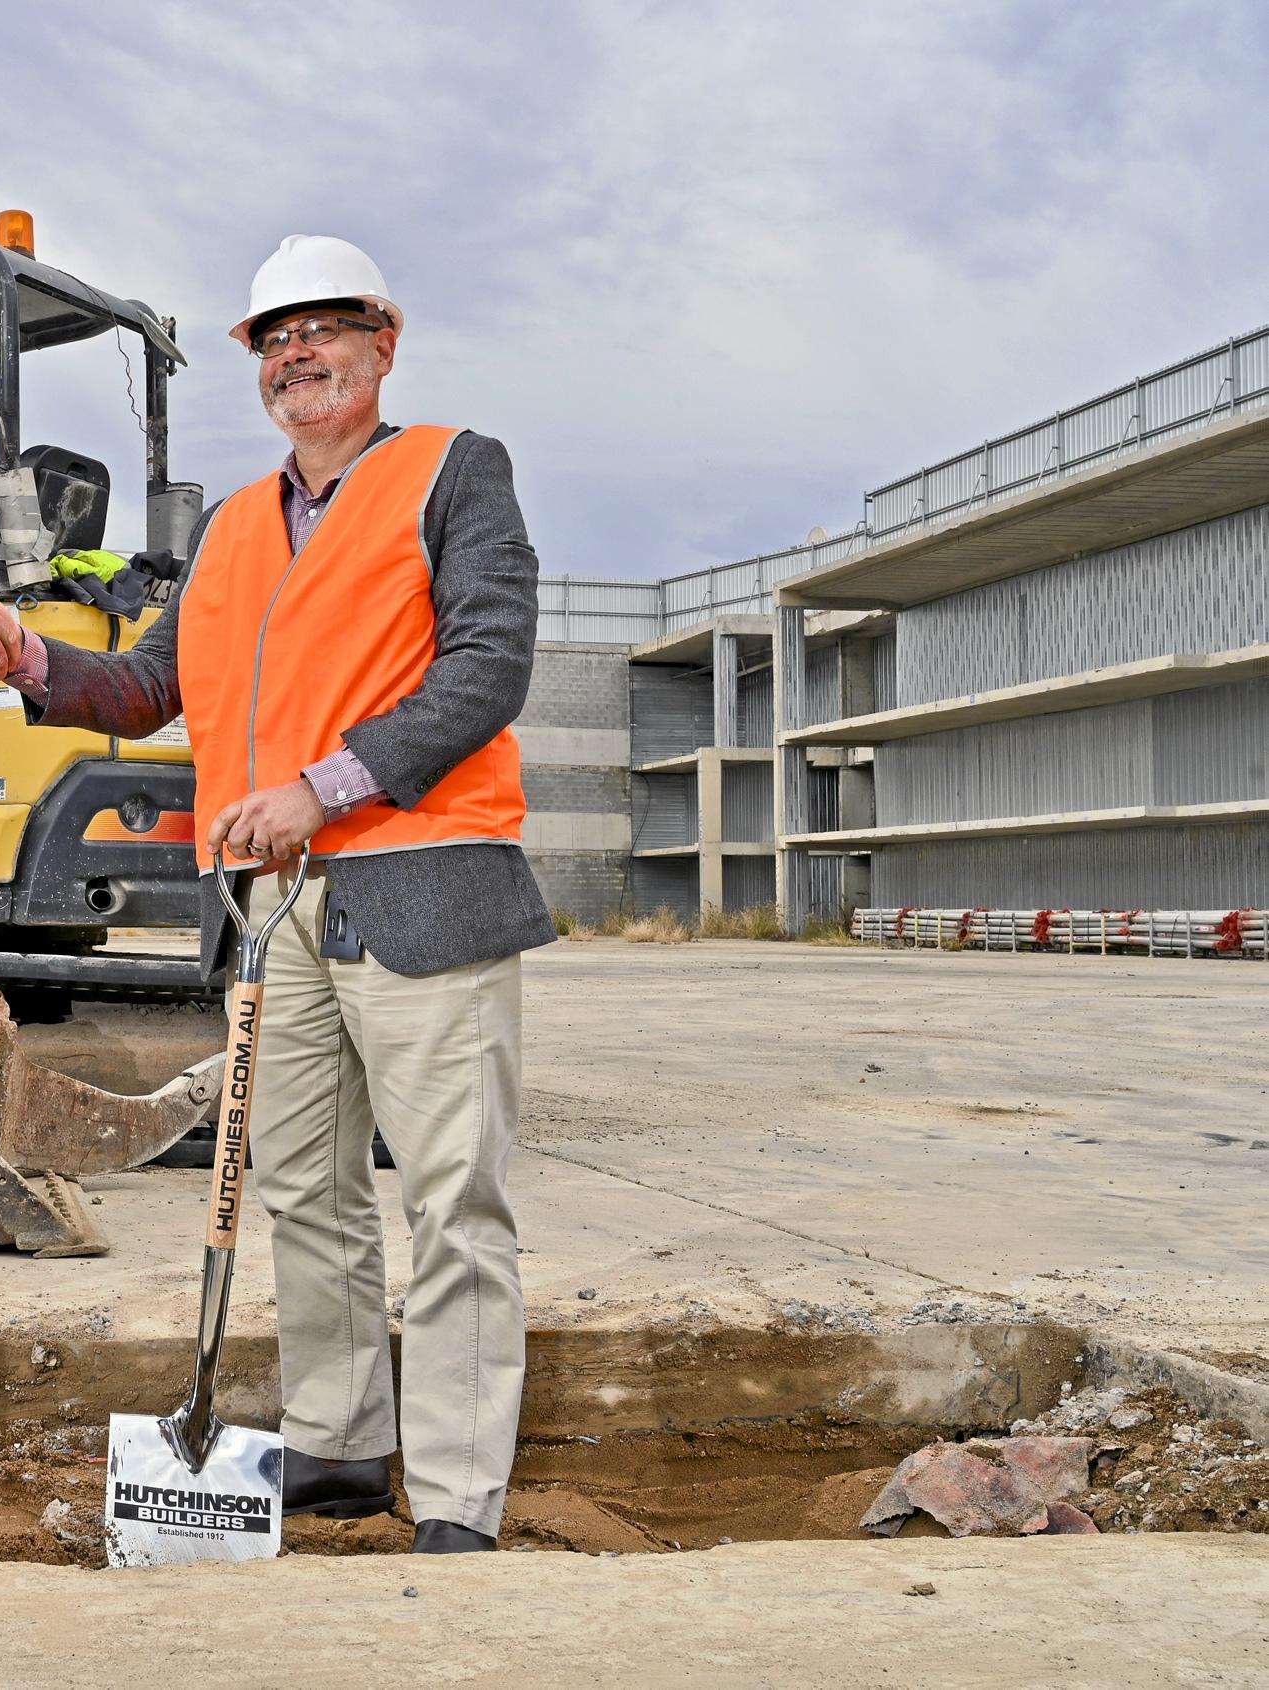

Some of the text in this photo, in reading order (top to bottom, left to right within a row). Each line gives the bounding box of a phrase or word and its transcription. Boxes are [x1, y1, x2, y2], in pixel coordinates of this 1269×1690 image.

[216, 1000, 257, 1232] HUTCHIES.COM.AU
[115, 1482, 271, 1516] HUTCHINSON
[137, 1507, 246, 1530] BUILDERS
[157, 1526, 225, 1541] Established 1912
